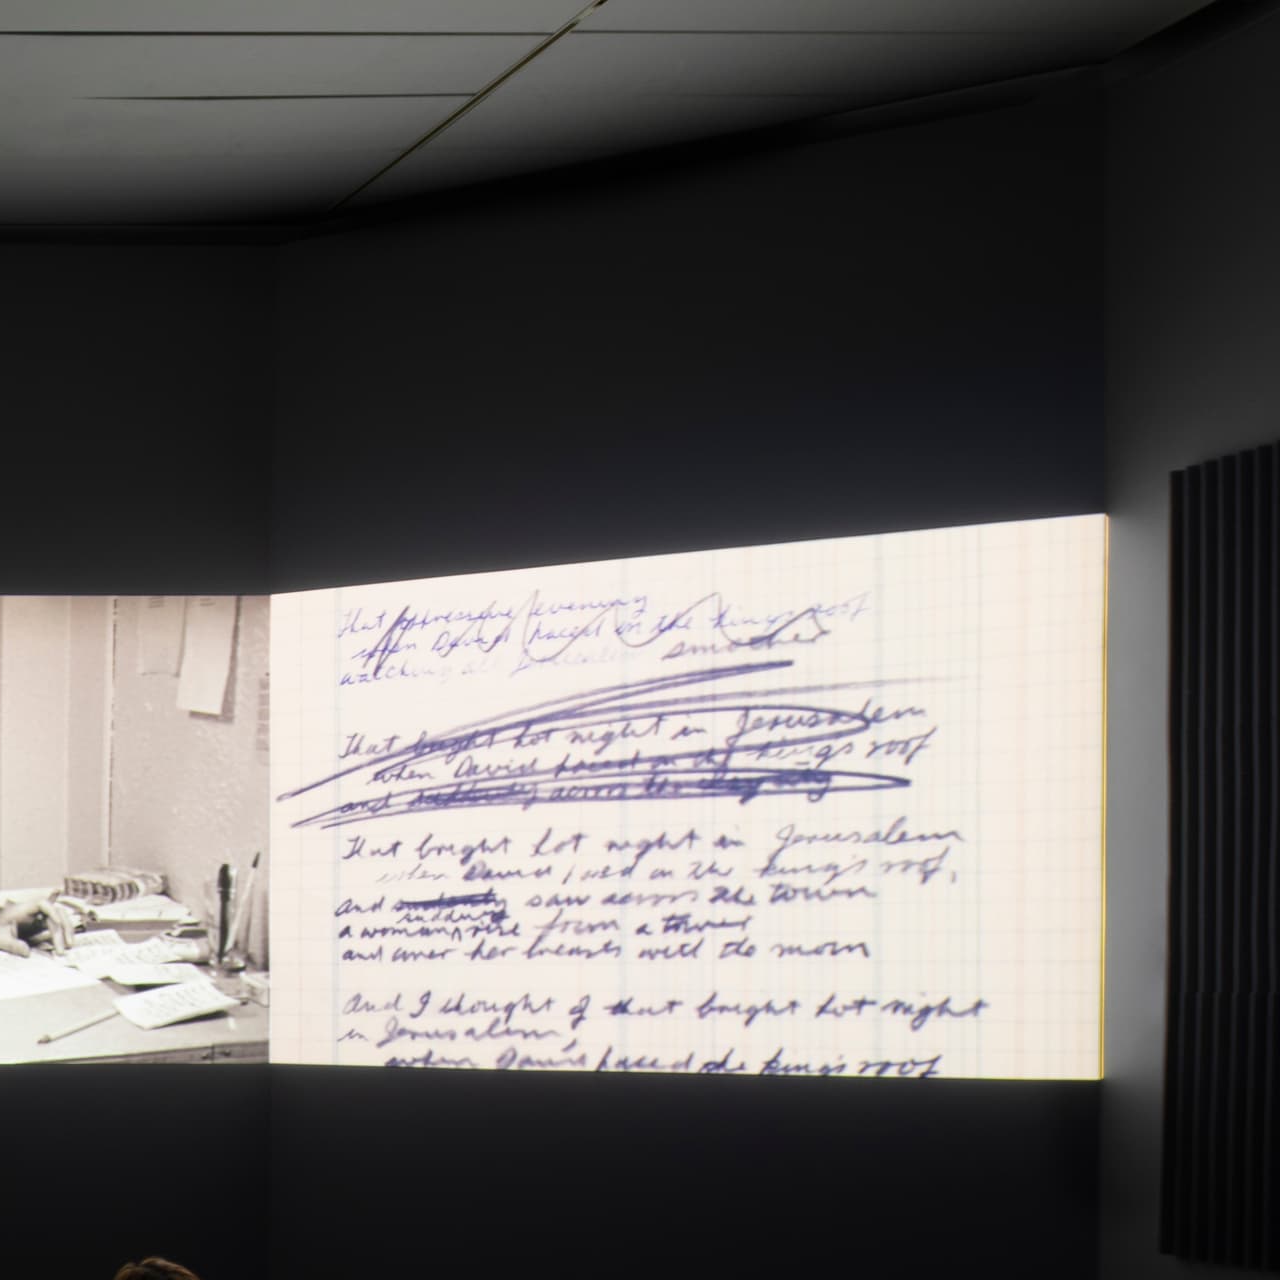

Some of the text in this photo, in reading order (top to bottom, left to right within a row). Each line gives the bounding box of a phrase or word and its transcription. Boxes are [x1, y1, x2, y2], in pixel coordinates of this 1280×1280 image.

[414, 832, 513, 867] bright
[605, 828, 702, 868] night
[766, 815, 967, 864] Jerusalem
[408, 989, 432, 1019] I
[439, 990, 556, 1025] thought
[694, 990, 802, 1028] bright
[814, 991, 878, 1019] hot
[880, 994, 992, 1033] night
